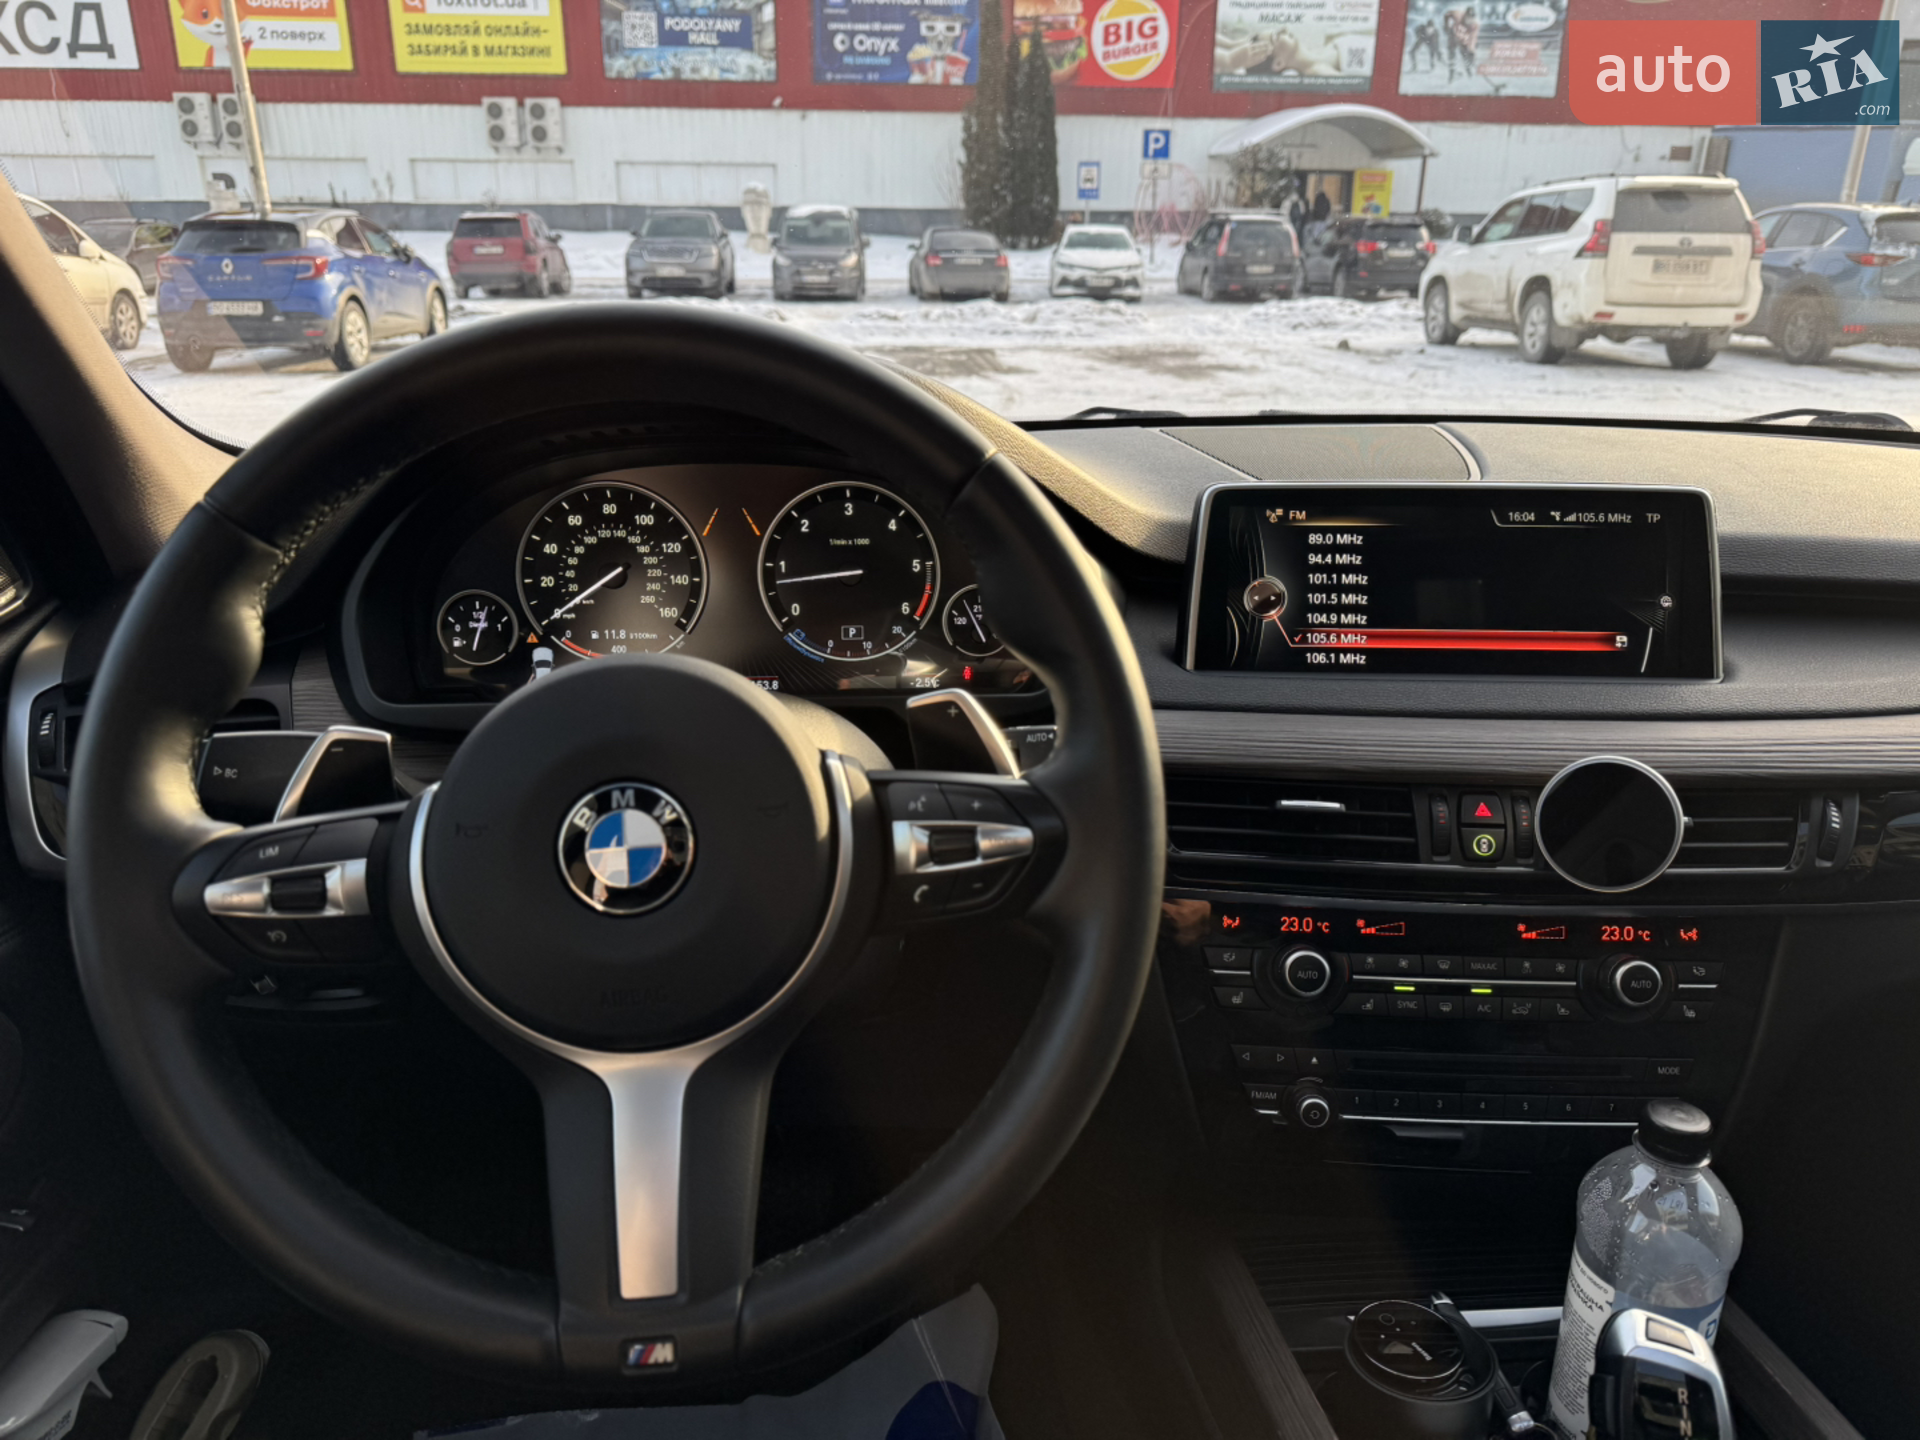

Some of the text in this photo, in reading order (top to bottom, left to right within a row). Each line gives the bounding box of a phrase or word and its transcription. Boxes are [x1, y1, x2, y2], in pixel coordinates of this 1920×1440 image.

[404, 21, 481, 37] ЗАМОВЛЯЙ
[664, 16, 742, 32] PODOLYANY
[257, 26, 326, 43] 2 поверх
[1103, 17, 1158, 46] BIG
[688, 31, 720, 45] HALL
[406, 41, 469, 57] ЗАБИРАЙ
[471, 45, 481, 57] В
[853, 34, 900, 56] Onyx
[1103, 41, 1158, 62] BURGER
[1148, 132, 1166, 157] P
[602, 504, 617, 514] 80
[845, 503, 853, 515] 3
[567, 515, 582, 525] 60
[635, 515, 654, 525] 100
[1289, 510, 1306, 520] FM
[1508, 512, 1535, 522] 16:04
[1578, 512, 1632, 523] 105.6 MHz
[1646, 513, 1661, 523] TP
[801, 519, 809, 532] 2
[888, 519, 897, 531] 4
[1308, 533, 1363, 545] 89.0 MHz
[543, 544, 557, 554] 40
[662, 543, 681, 553] 120
[1308, 554, 1362, 565] 94.4 MHz
[779, 561, 786, 572] 1
[912, 560, 920, 572] 5
[540, 576, 554, 587] 20
[670, 575, 689, 585] 140
[1308, 574, 1368, 585] 101.1 MHz
[1307, 594, 1368, 605] 101.5 MHz
[659, 607, 678, 618] 160
[791, 603, 800, 616] 0
[901, 603, 910, 615] 6
[953, 616, 967, 625] 120
[1307, 613, 1367, 624] 104.9 MHz
[455, 624, 461, 632] 0
[497, 624, 502, 632] 1
[849, 627, 856, 637] P
[892, 626, 902, 634] 20
[565, 630, 572, 638] 0
[604, 629, 626, 639] 11.8
[1306, 633, 1367, 644] 105.6 MHz
[611, 645, 627, 653] 400
[827, 640, 834, 648] 0
[1305, 653, 1366, 664] 106.1 MHz
[1026, 733, 1047, 743] AUTO
[224, 768, 238, 778] BC
[573, 788, 678, 832] BMW
[258, 846, 279, 859] LIM
[1280, 916, 1313, 932] 23.0
[1601, 926, 1634, 941] 23.0
[1297, 971, 1318, 979] AUTO
[1630, 980, 1651, 988] AUTO
[1477, 1004, 1491, 1012] A/C
[1657, 1067, 1680, 1075] MODE
[1251, 1091, 1277, 1100] FM/AM
[1393, 1098, 1399, 1107] 2
[1437, 1100, 1443, 1108] 3
[1522, 1102, 1528, 1110] 5
[1566, 1103, 1571, 1112] 6
[1609, 1103, 1615, 1112] 7
[1677, 1387, 1689, 1404] R
[1680, 1419, 1692, 1437] N
